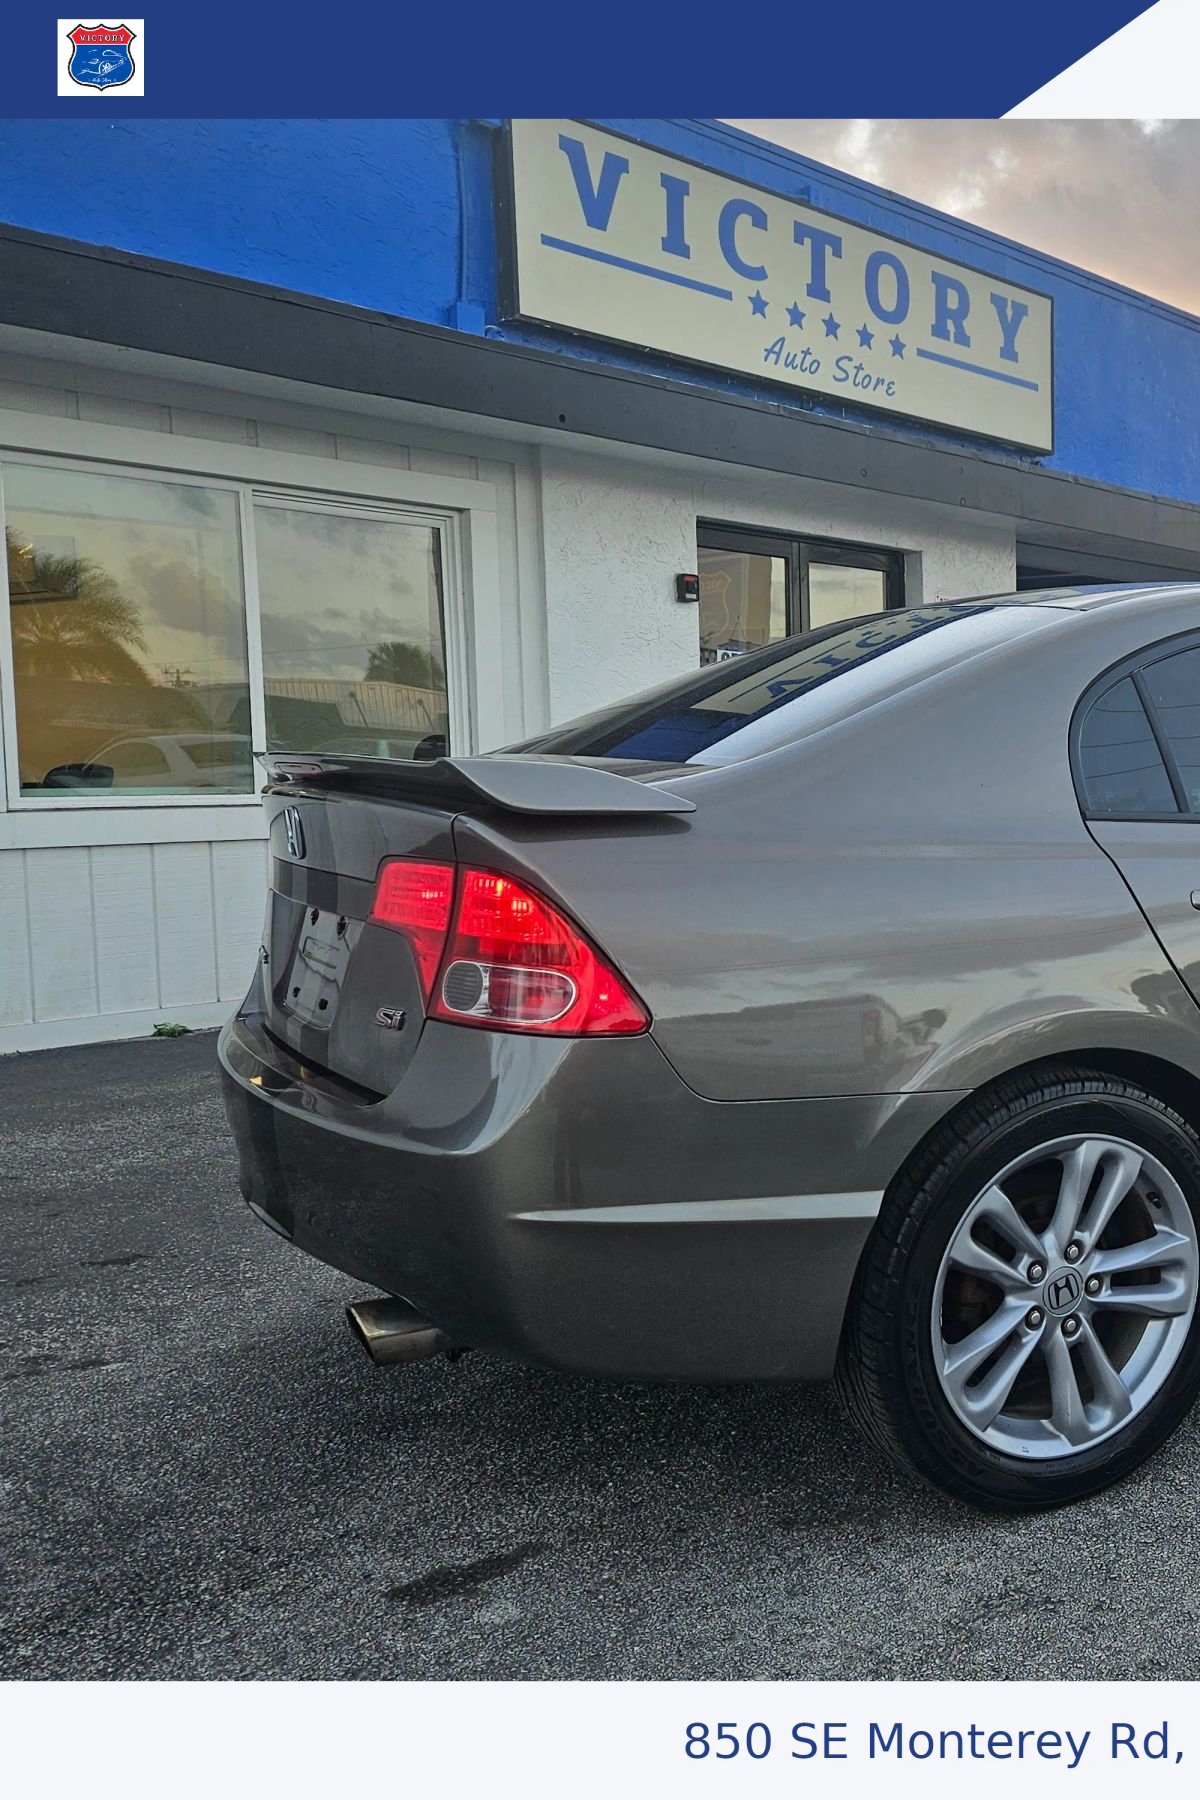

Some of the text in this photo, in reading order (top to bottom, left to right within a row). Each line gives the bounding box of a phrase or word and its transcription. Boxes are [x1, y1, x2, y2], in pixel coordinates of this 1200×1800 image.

[558, 134, 1028, 363] VICTORY
[763, 336, 896, 397] Auto Store
[374, 1007, 404, 1030] Si
